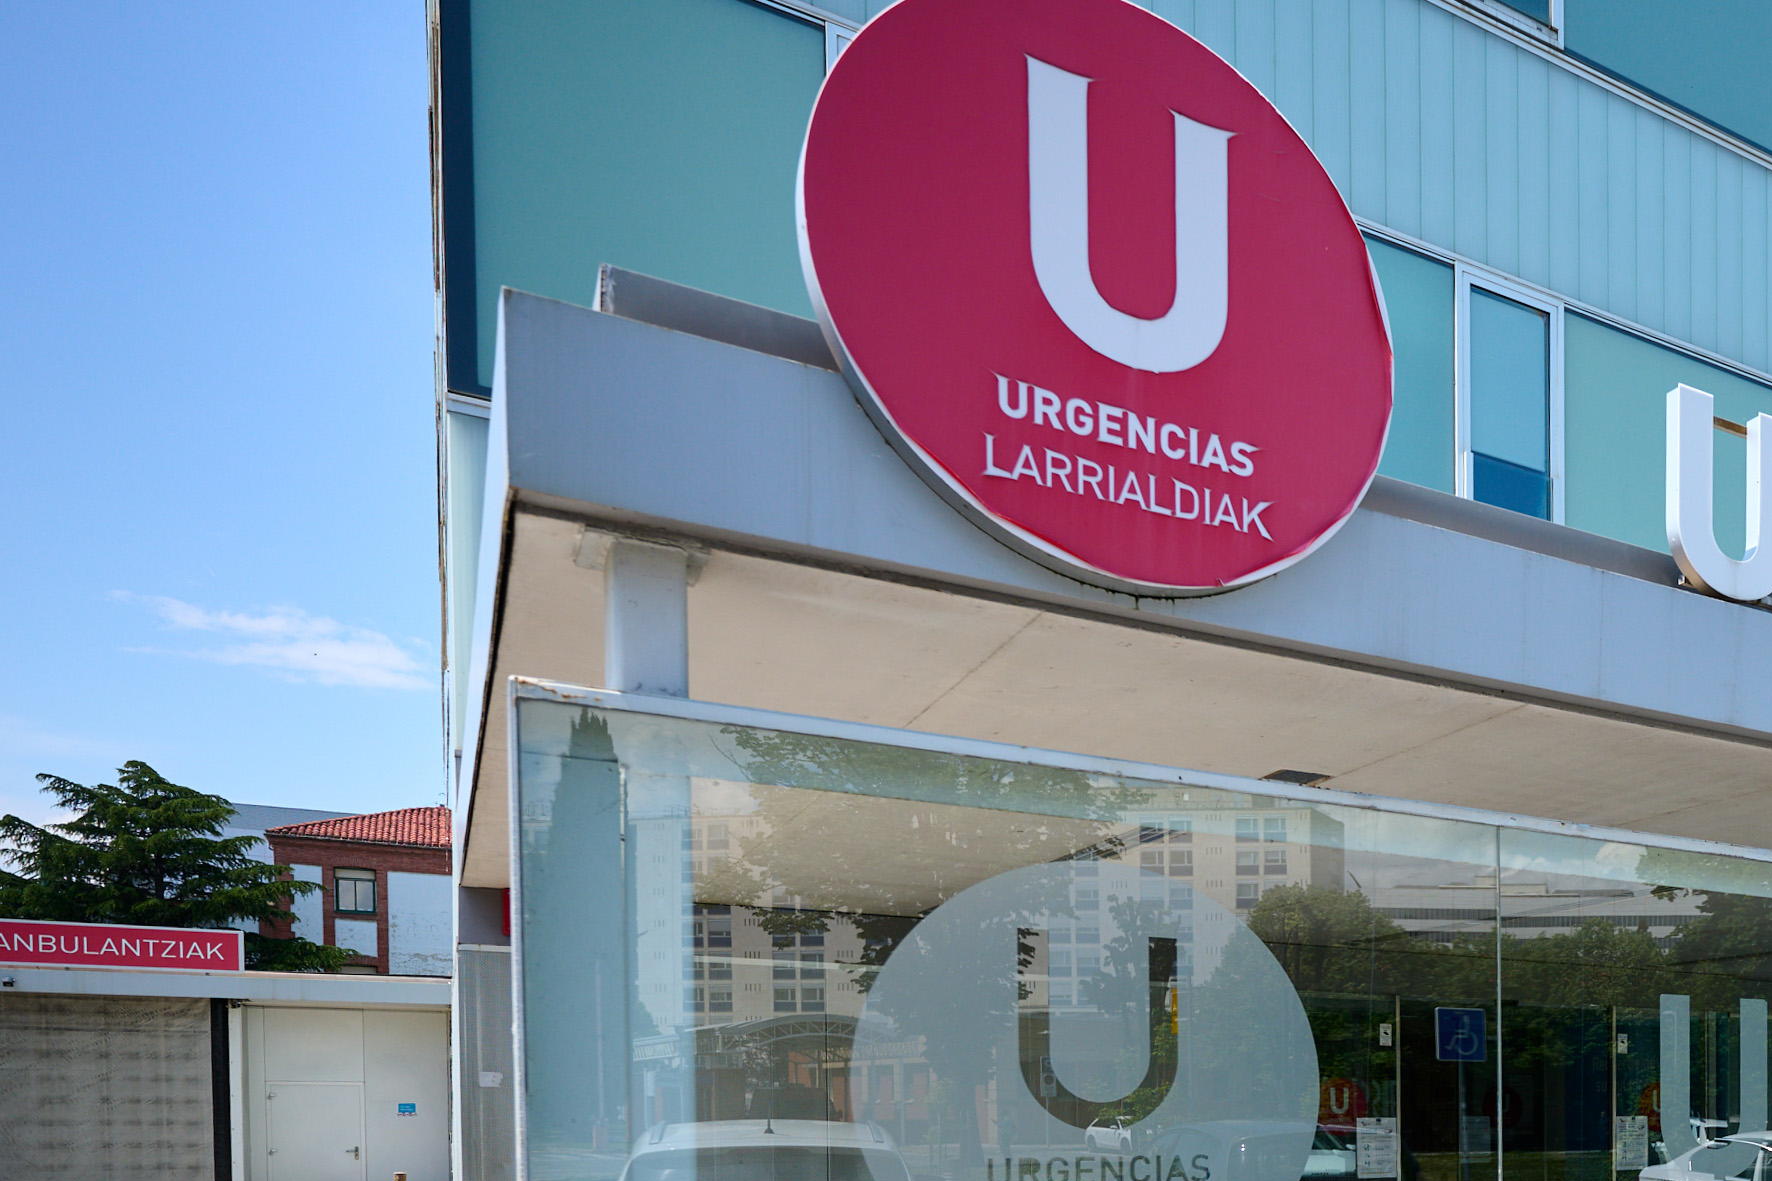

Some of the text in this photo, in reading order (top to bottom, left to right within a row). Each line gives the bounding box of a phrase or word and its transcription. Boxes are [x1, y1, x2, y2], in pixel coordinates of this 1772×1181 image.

[1025, 54, 1240, 374] U
[993, 372, 1260, 478] URGENCIAS
[983, 433, 1274, 541] LARRIALDIAK
[0, 932, 224, 961] ANBULANTZIAK
[1017, 927, 1178, 1130] U
